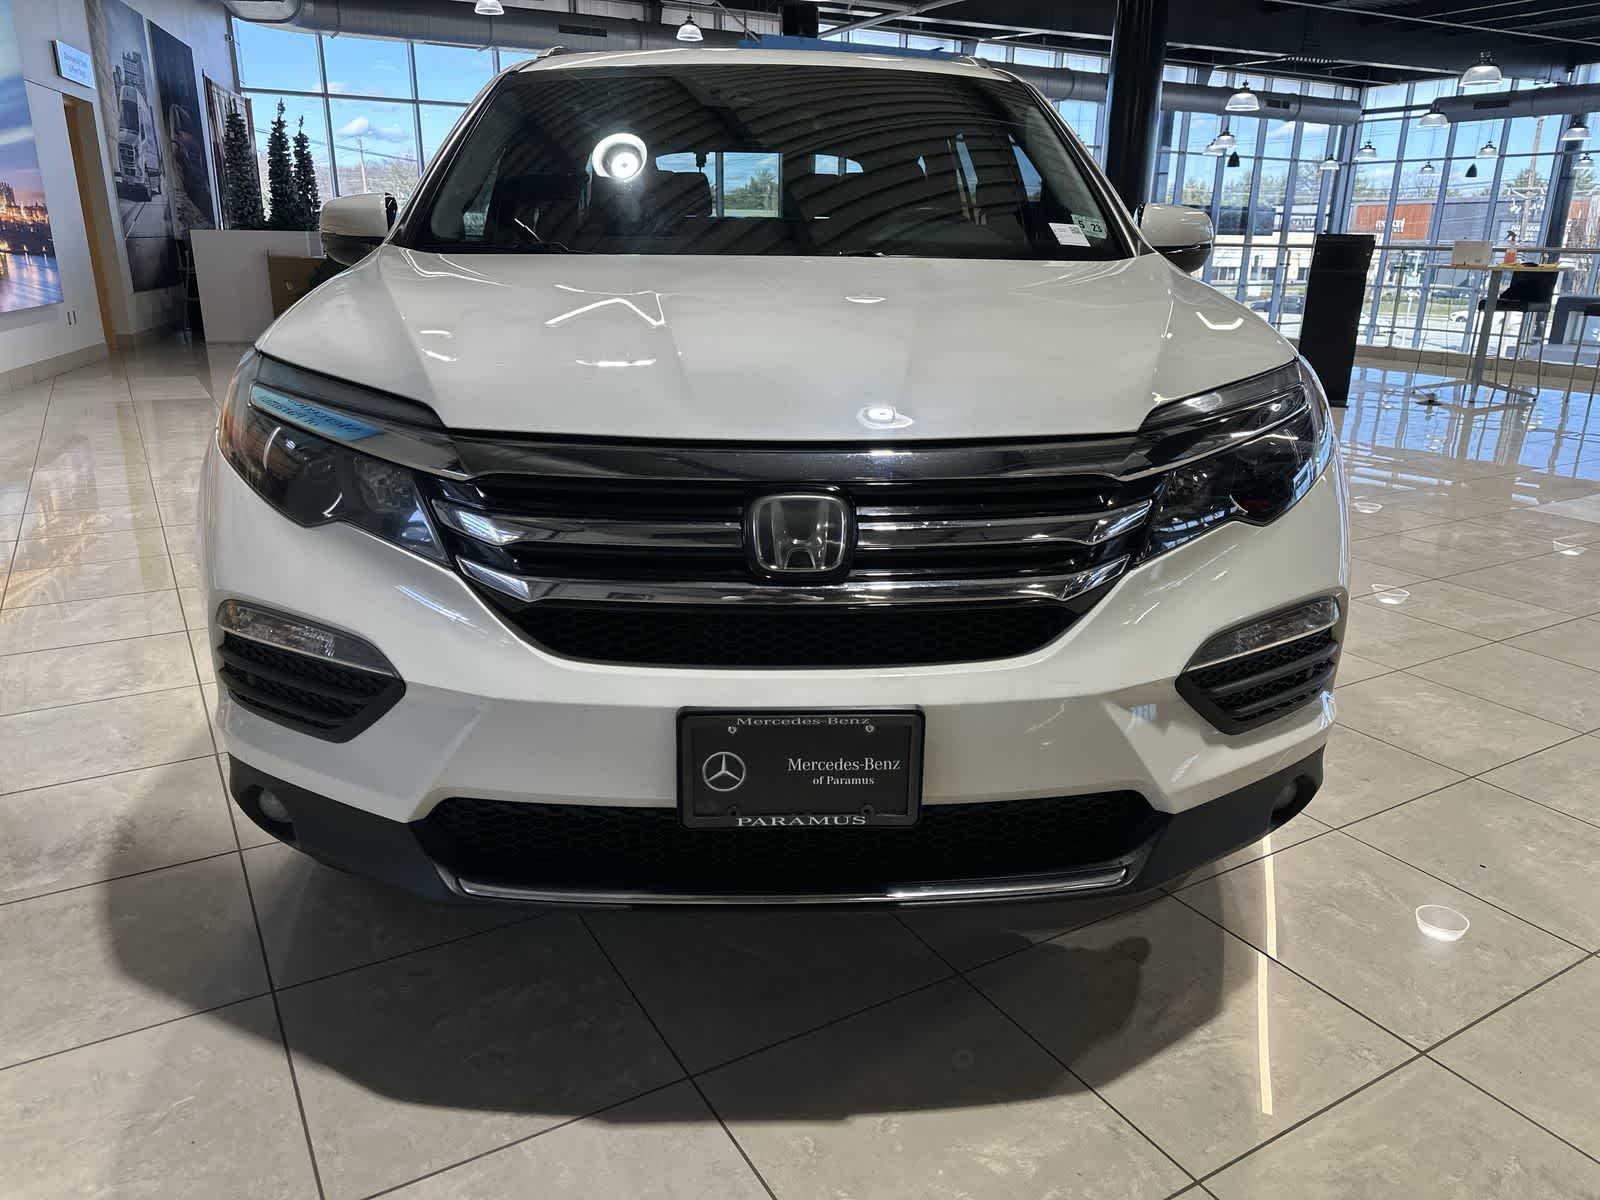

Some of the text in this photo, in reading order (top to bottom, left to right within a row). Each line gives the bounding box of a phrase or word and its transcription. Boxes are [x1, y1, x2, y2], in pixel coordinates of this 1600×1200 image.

[736, 716, 871, 726] Mercedes-Benz
[787, 757, 902, 772] Mercedes-Benz
[812, 775, 875, 785] of Paramus
[736, 815, 867, 827] PARAMUS
